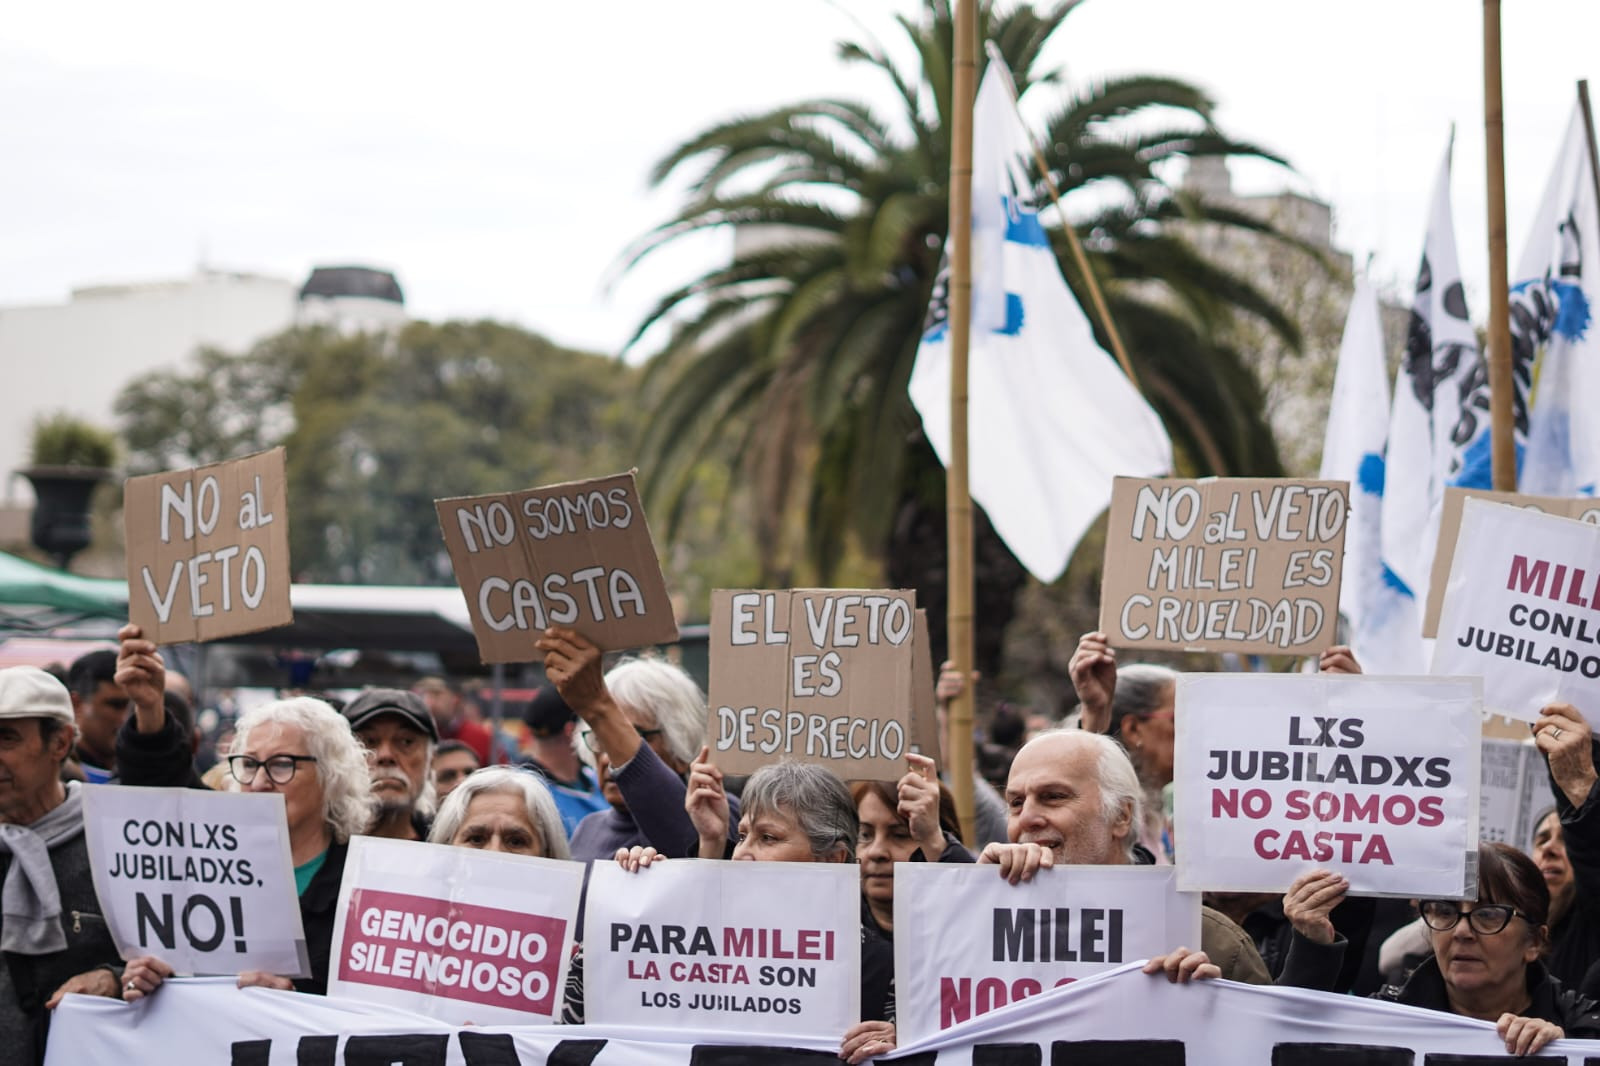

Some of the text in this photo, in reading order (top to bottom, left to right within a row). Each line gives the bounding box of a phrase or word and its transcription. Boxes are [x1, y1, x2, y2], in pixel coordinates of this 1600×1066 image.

[160, 475, 220, 543] NO
[457, 488, 632, 553] NO SOMOS
[1131, 485, 1201, 542] NO
[1252, 485, 1345, 543] VETO
[142, 546, 266, 623] VETO
[1148, 545, 1334, 591] MILEI ES
[478, 567, 646, 632] CASTA
[731, 593, 911, 649] EL VETO
[1120, 594, 1324, 648] CRUELDAD
[1576, 618, 1600, 645] L
[793, 651, 842, 697] ES
[716, 706, 904, 760] DESPRECIO
[1289, 716, 1365, 749] LXS
[1206, 750, 1452, 788] JUBILADXS
[1211, 788, 1445, 827] NO SOMOS
[123, 819, 238, 851] CON LXS
[1254, 829, 1394, 865] CASTA
[109, 853, 263, 887] JUBILADXS,
[135, 892, 247, 953] NO!
[360, 907, 548, 963] GENOCIDIO
[610, 922, 835, 960] PARA MILEI
[993, 908, 1123, 963] MILEI
[348, 942, 550, 1001] SILENCIOSO
[628, 960, 816, 987] LA CASTA SON
[641, 991, 681, 1008] LOS
